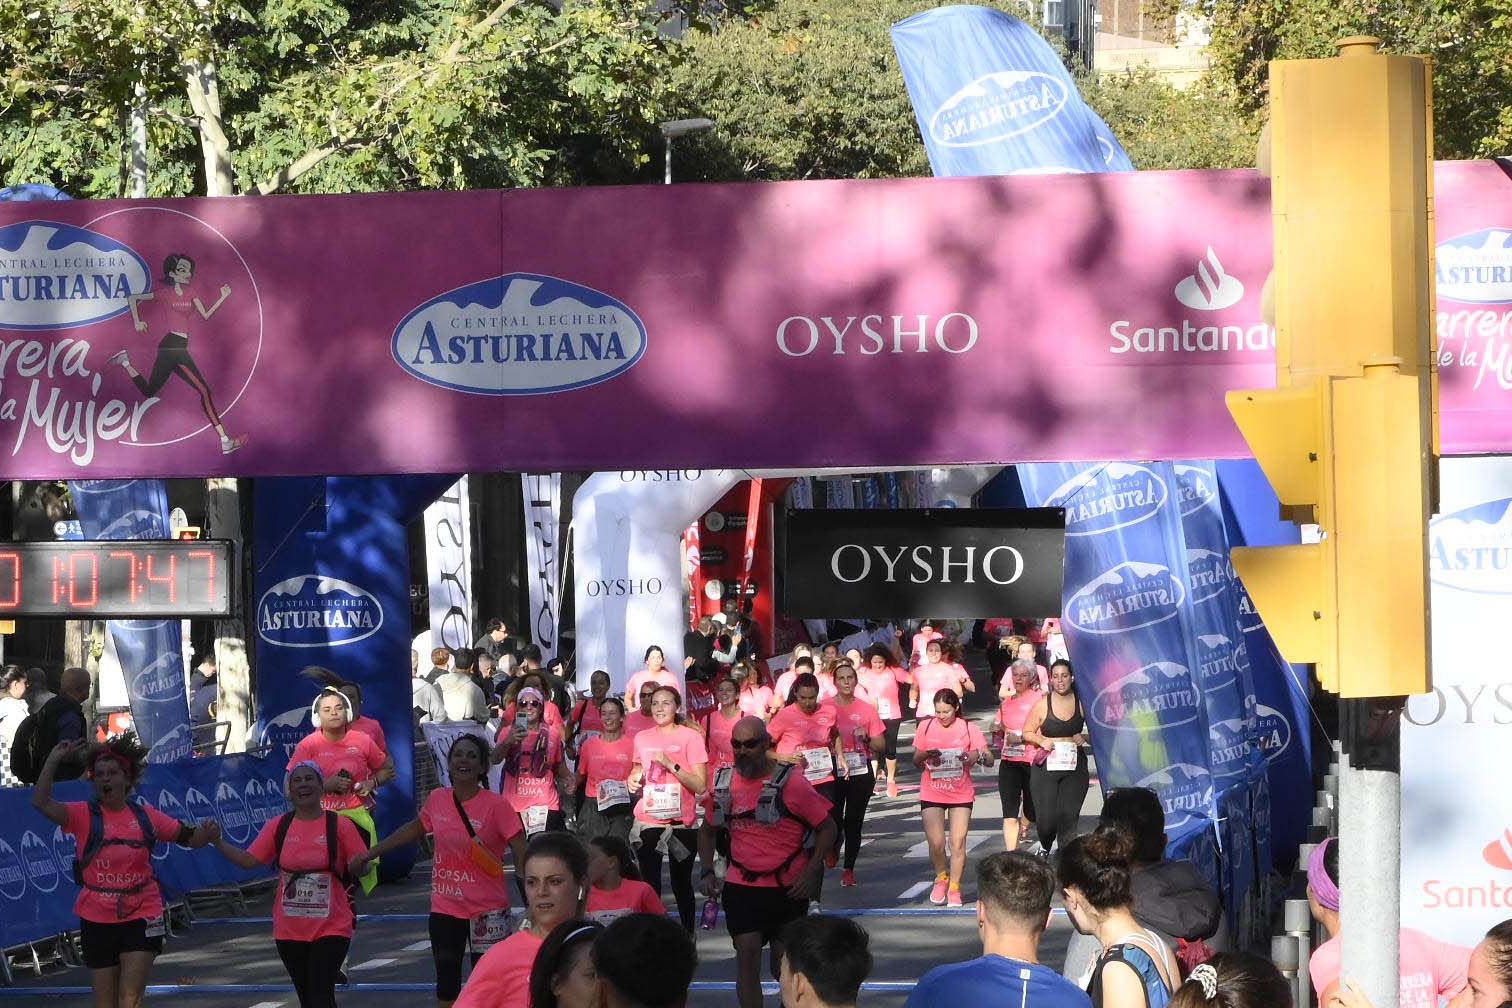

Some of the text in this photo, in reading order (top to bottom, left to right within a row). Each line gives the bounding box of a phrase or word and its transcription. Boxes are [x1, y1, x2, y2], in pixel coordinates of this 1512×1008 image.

[54, 257, 127, 268] LECHERA
[451, 313, 618, 328] CENTRAL LECHERA
[776, 311, 979, 357] OYSHO
[411, 320, 627, 365] ASTURIANA
[12, 374, 161, 467] Mujer
[830, 543, 1025, 586] OYSHO
[586, 577, 662, 597] OYSHO
[273, 599, 370, 608] CENTRAL LECHERA
[261, 604, 374, 632] ASTURIANA
